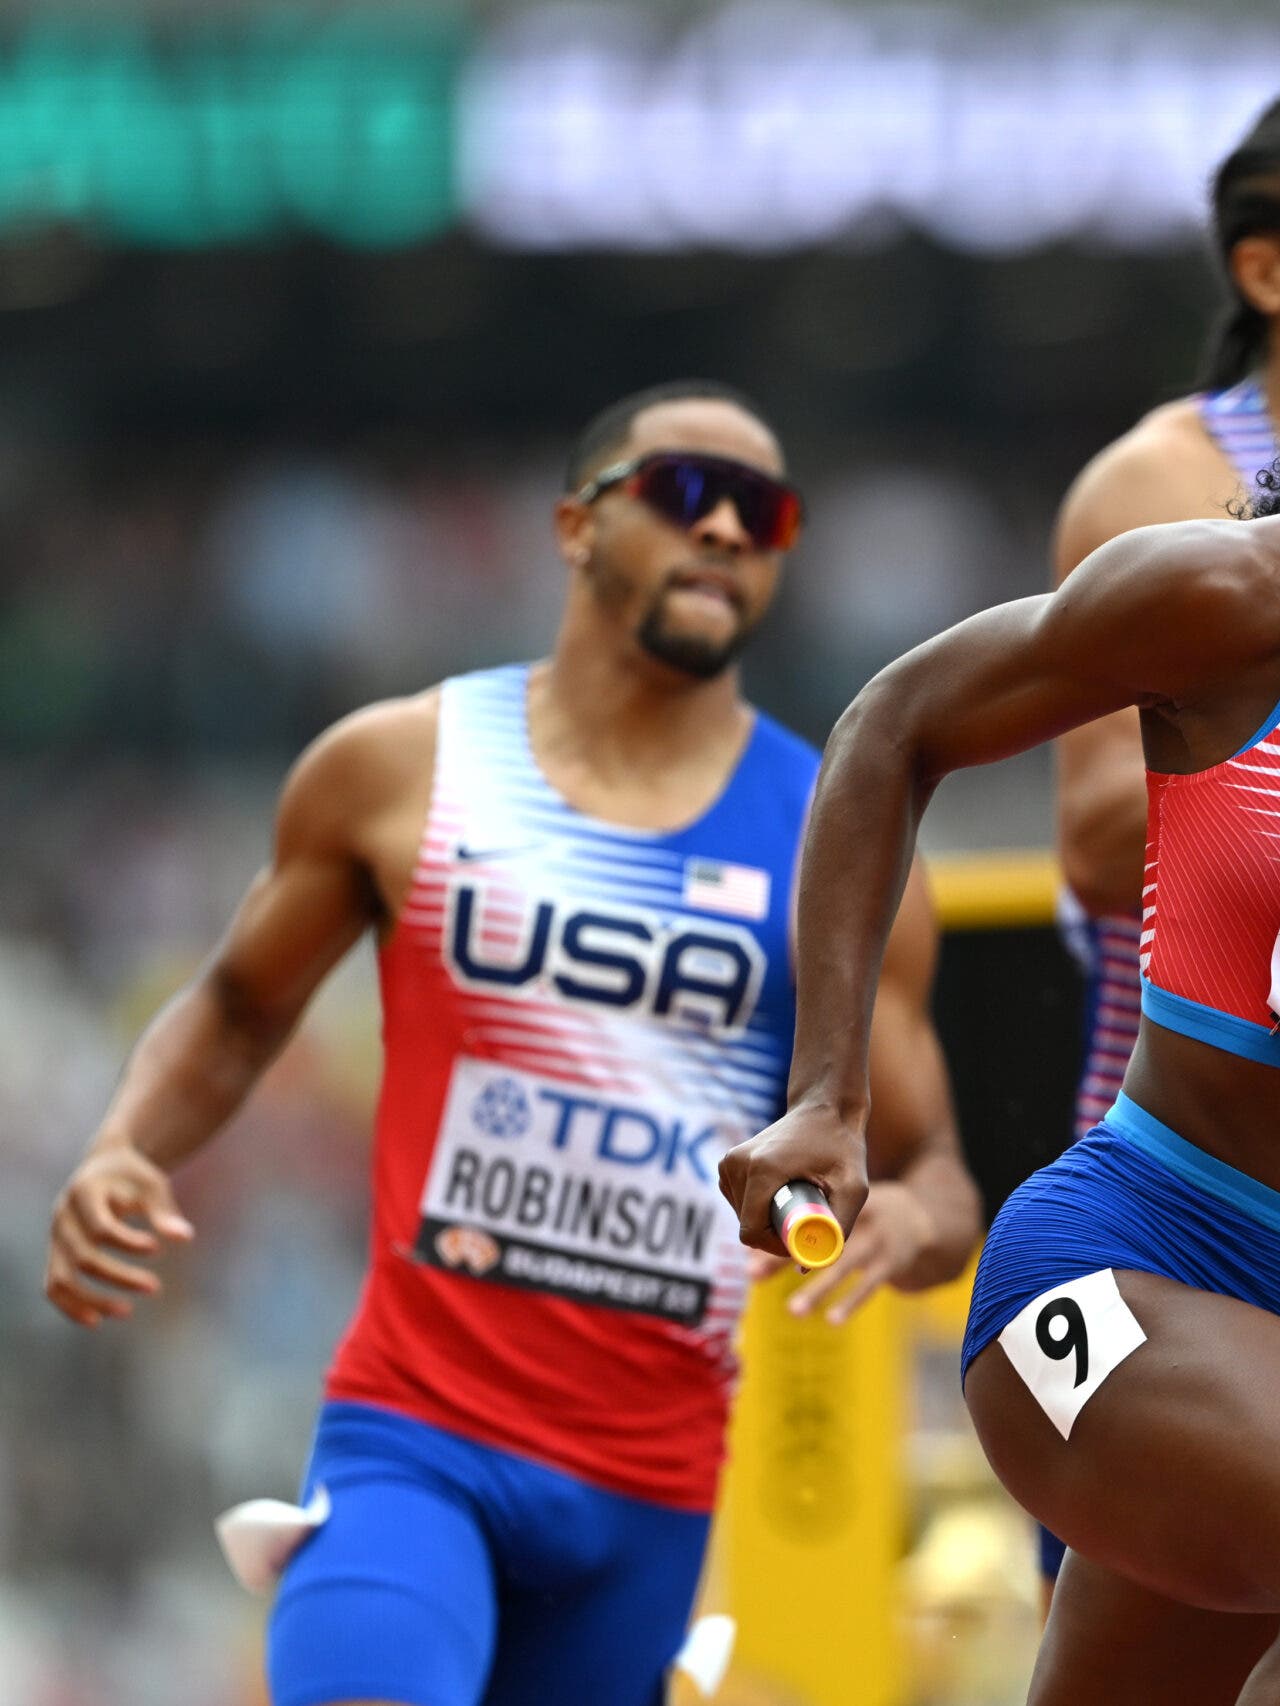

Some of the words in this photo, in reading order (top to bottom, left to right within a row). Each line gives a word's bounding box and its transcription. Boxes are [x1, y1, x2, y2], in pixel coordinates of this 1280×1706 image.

[449, 883, 758, 1032] USA
[538, 1089, 717, 1182] TDK
[444, 1148, 716, 1262] ROBINSON
[1034, 1296, 1090, 1390] 9
